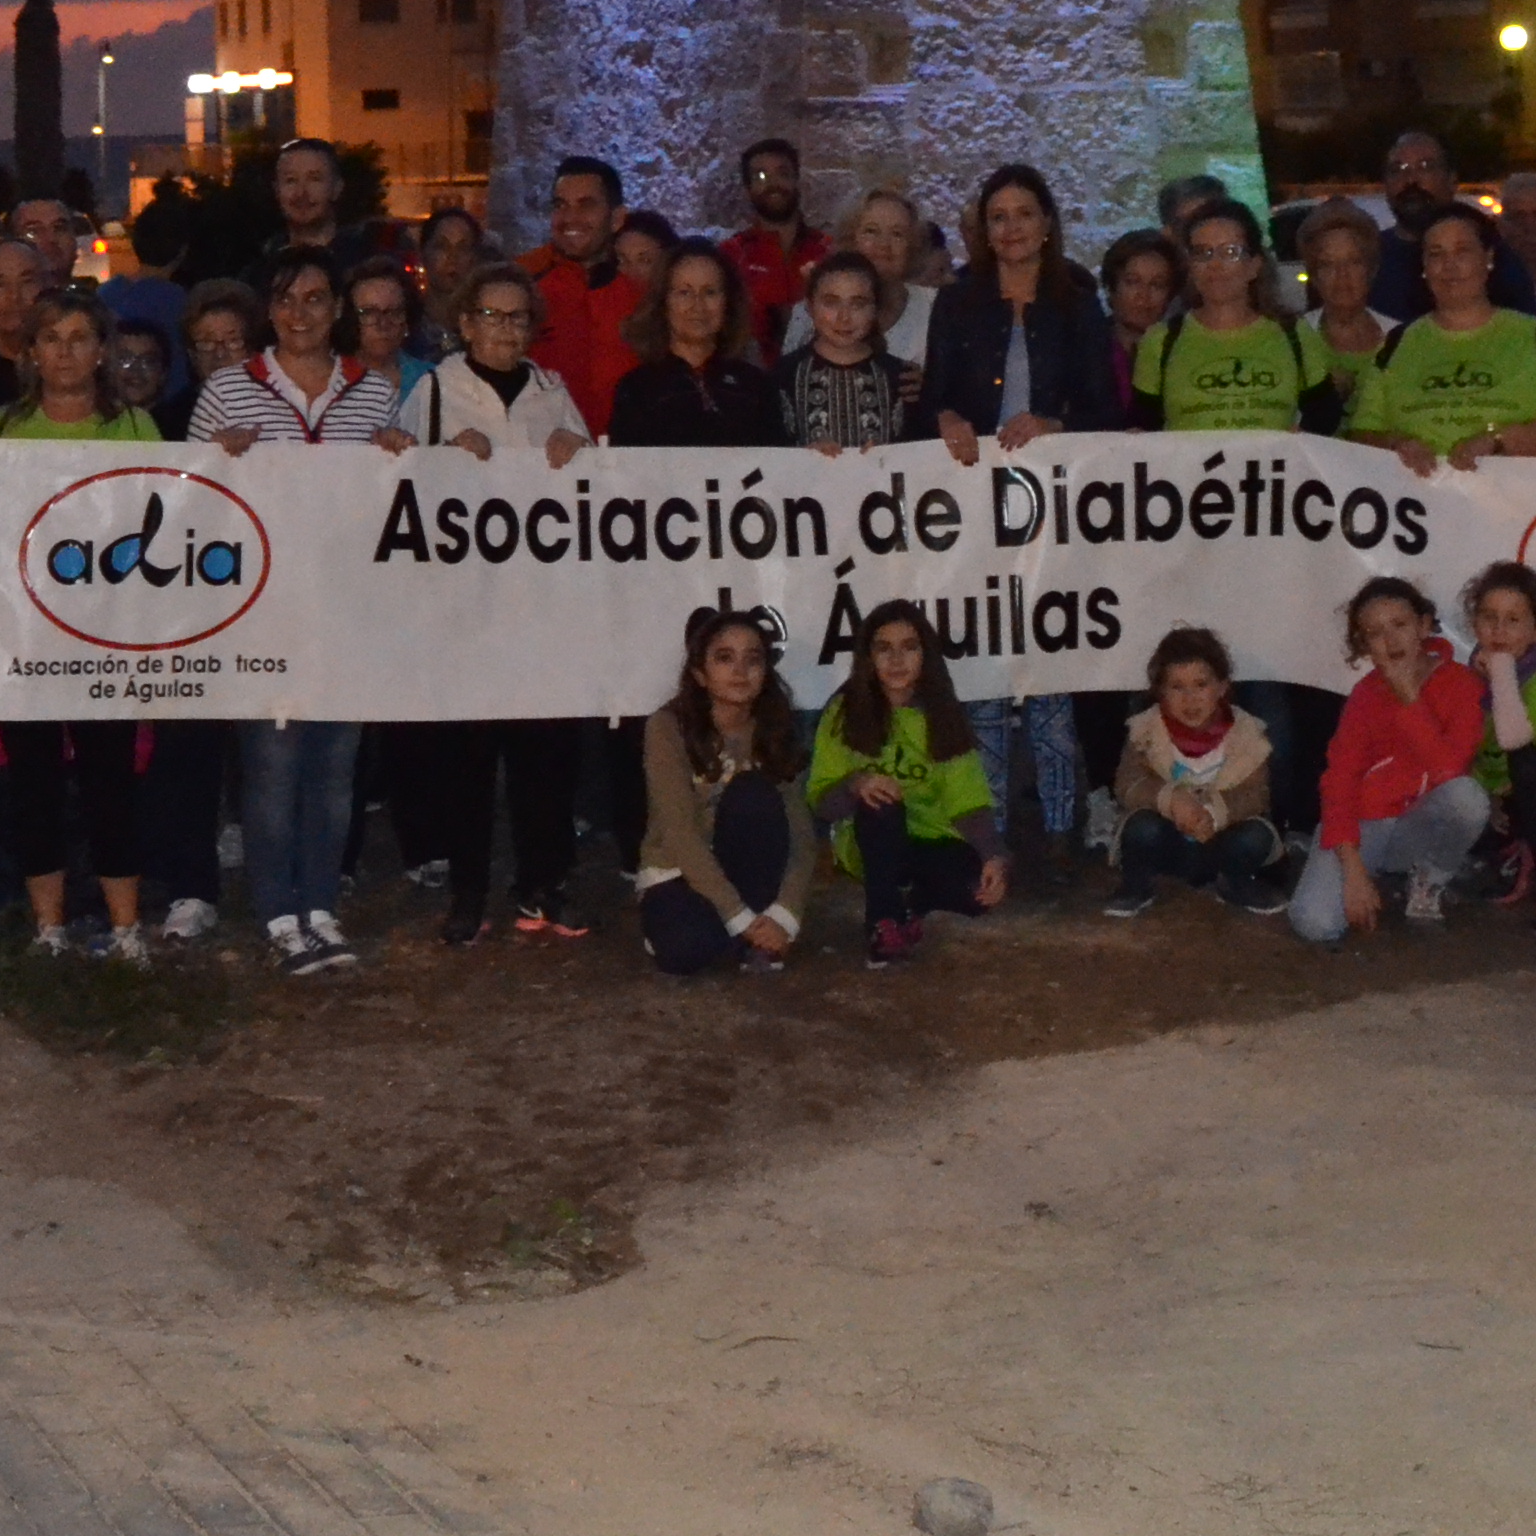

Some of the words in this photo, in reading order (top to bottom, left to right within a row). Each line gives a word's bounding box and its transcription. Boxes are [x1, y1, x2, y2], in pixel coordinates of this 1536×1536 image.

[47, 491, 242, 587] adia
[374, 468, 829, 564] Asociación
[860, 472, 962, 554] de
[993, 449, 1429, 557] Diabéticos
[818, 556, 1121, 667] Áuilas
[89, 680, 115, 698] de
[123, 675, 204, 702] Águilas
[136, 655, 163, 673] de
[171, 655, 288, 673] Diabticos
